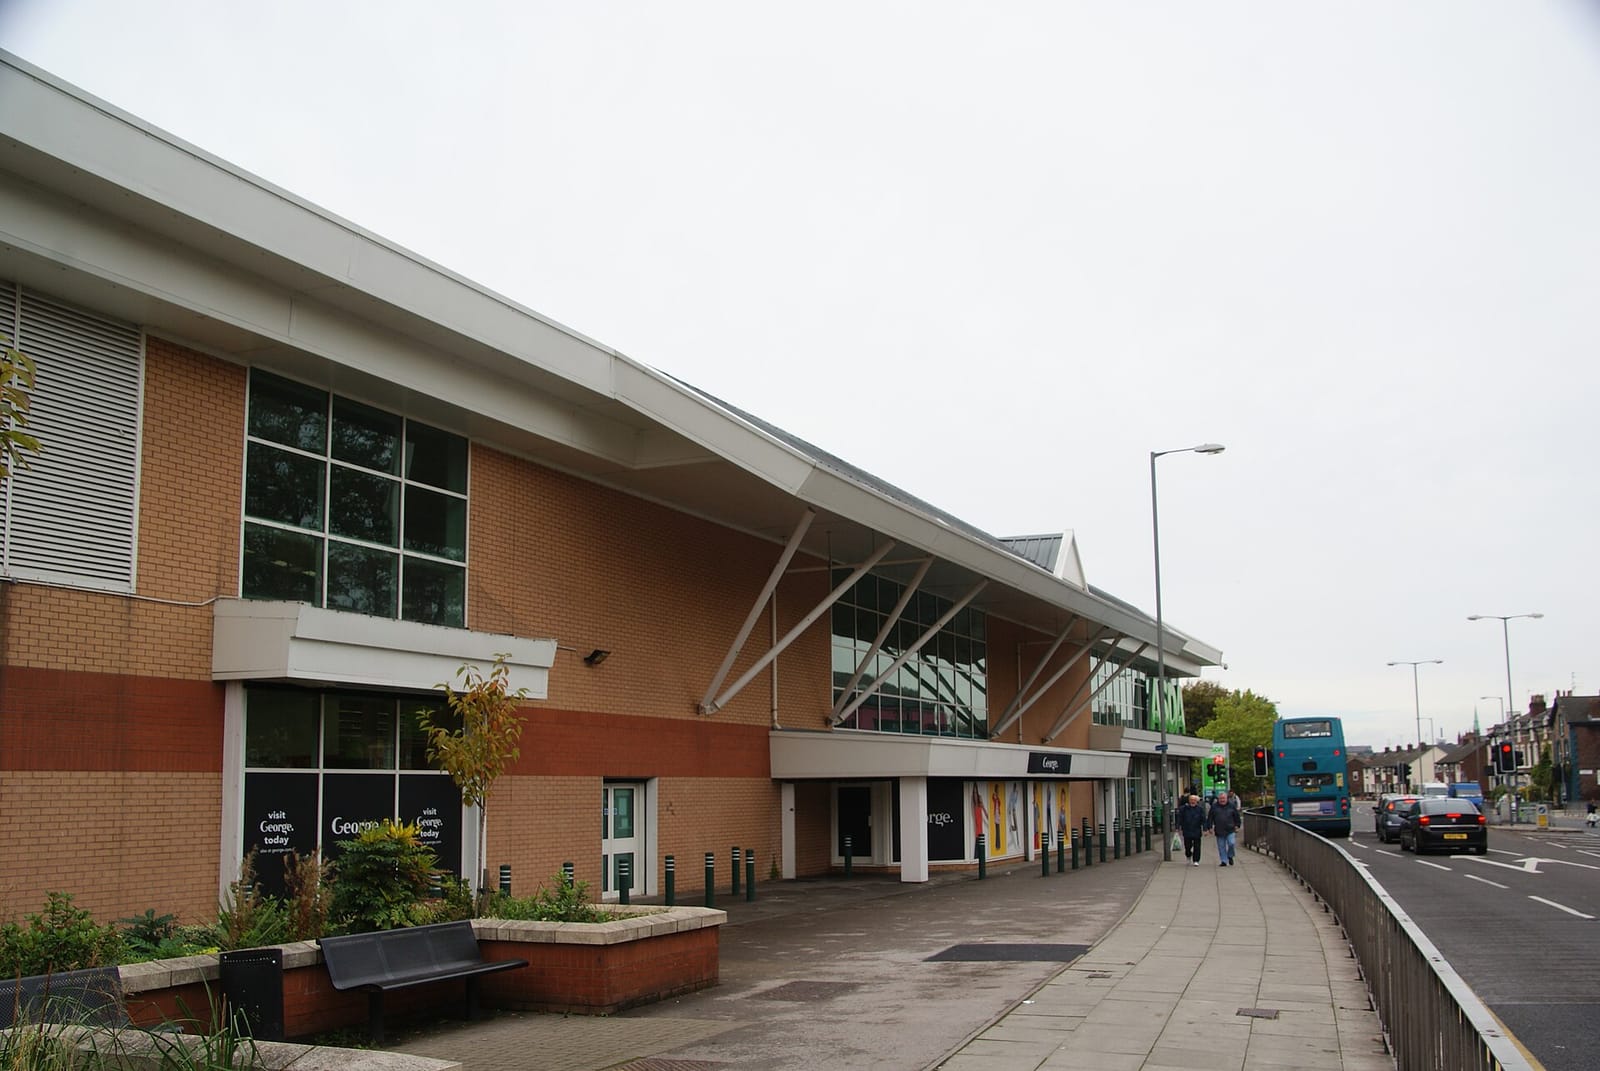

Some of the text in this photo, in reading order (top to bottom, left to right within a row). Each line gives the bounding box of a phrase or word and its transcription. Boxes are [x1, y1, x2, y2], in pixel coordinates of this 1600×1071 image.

[267, 810, 286, 819] visit
[422, 807, 437, 816] visit
[927, 812, 953, 828] rge.
[259, 820, 294, 835] George.
[420, 829, 440, 839] today
[264, 835, 289, 846] today
